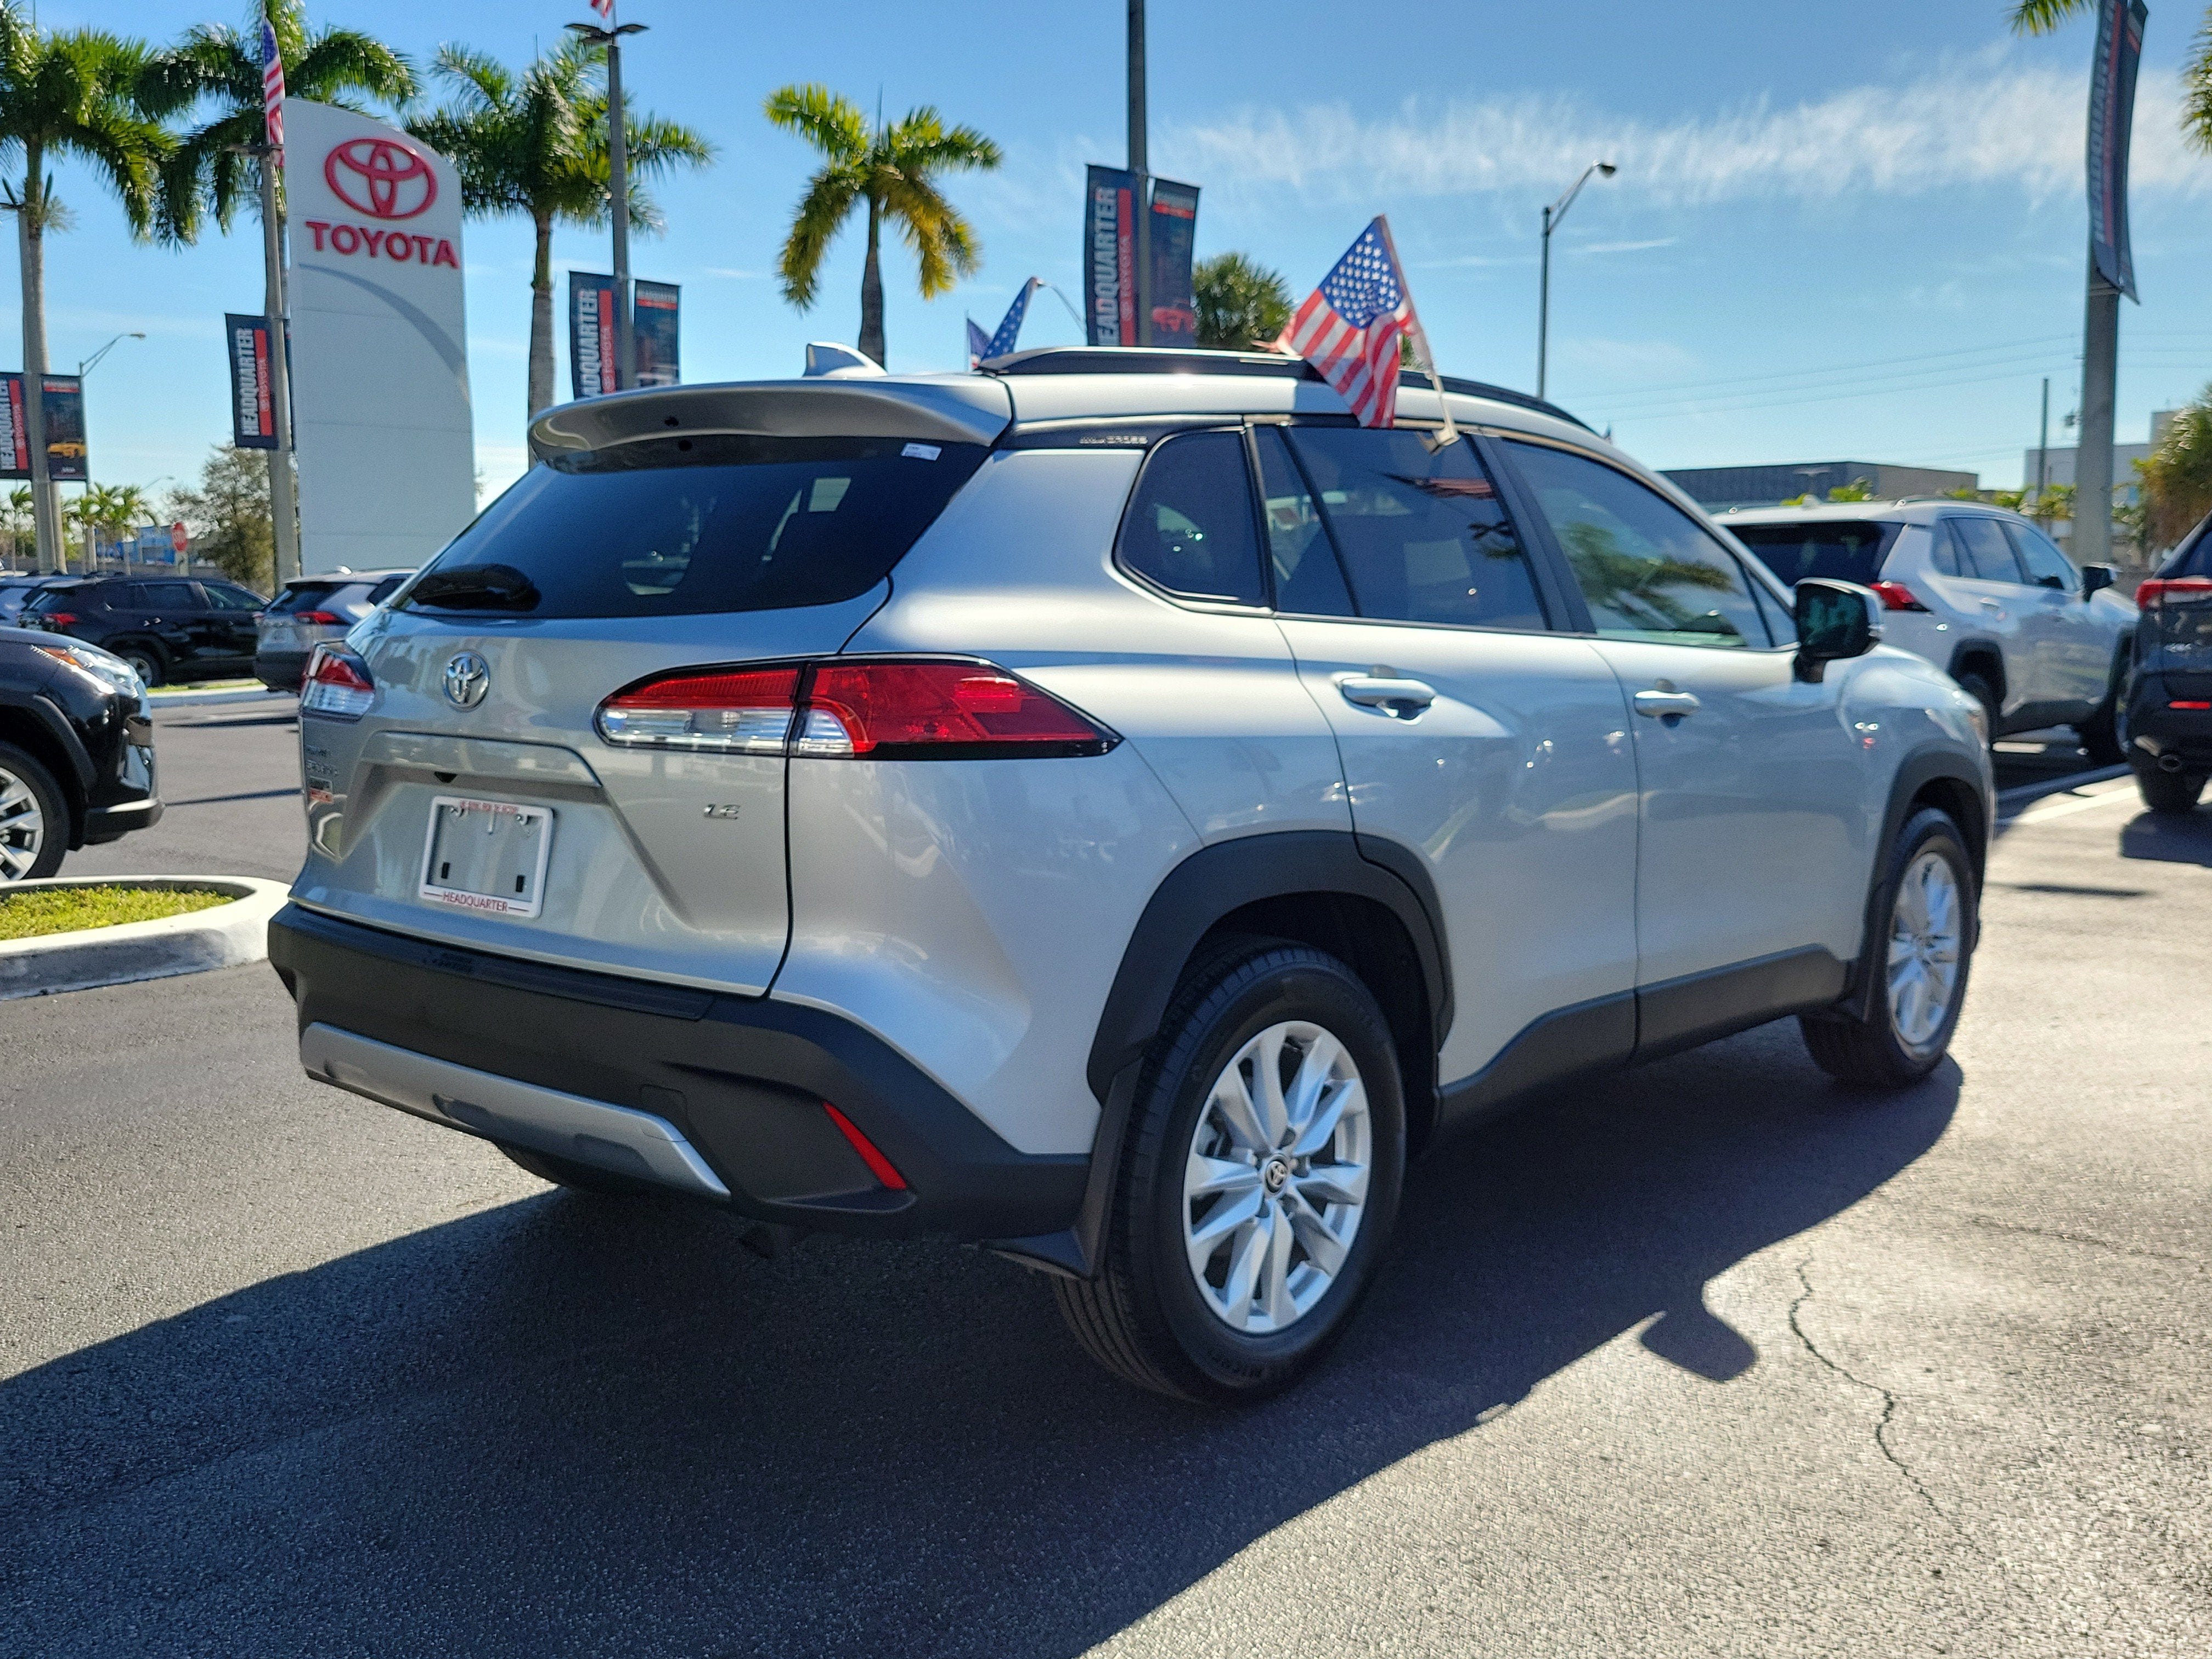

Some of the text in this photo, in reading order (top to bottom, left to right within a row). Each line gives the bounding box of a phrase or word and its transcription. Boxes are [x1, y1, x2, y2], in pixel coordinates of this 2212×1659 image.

[306, 221, 460, 269] TOYOTA
[235, 328, 260, 437] HEADQUARTER
[443, 891, 509, 912] HEADQUARTER
